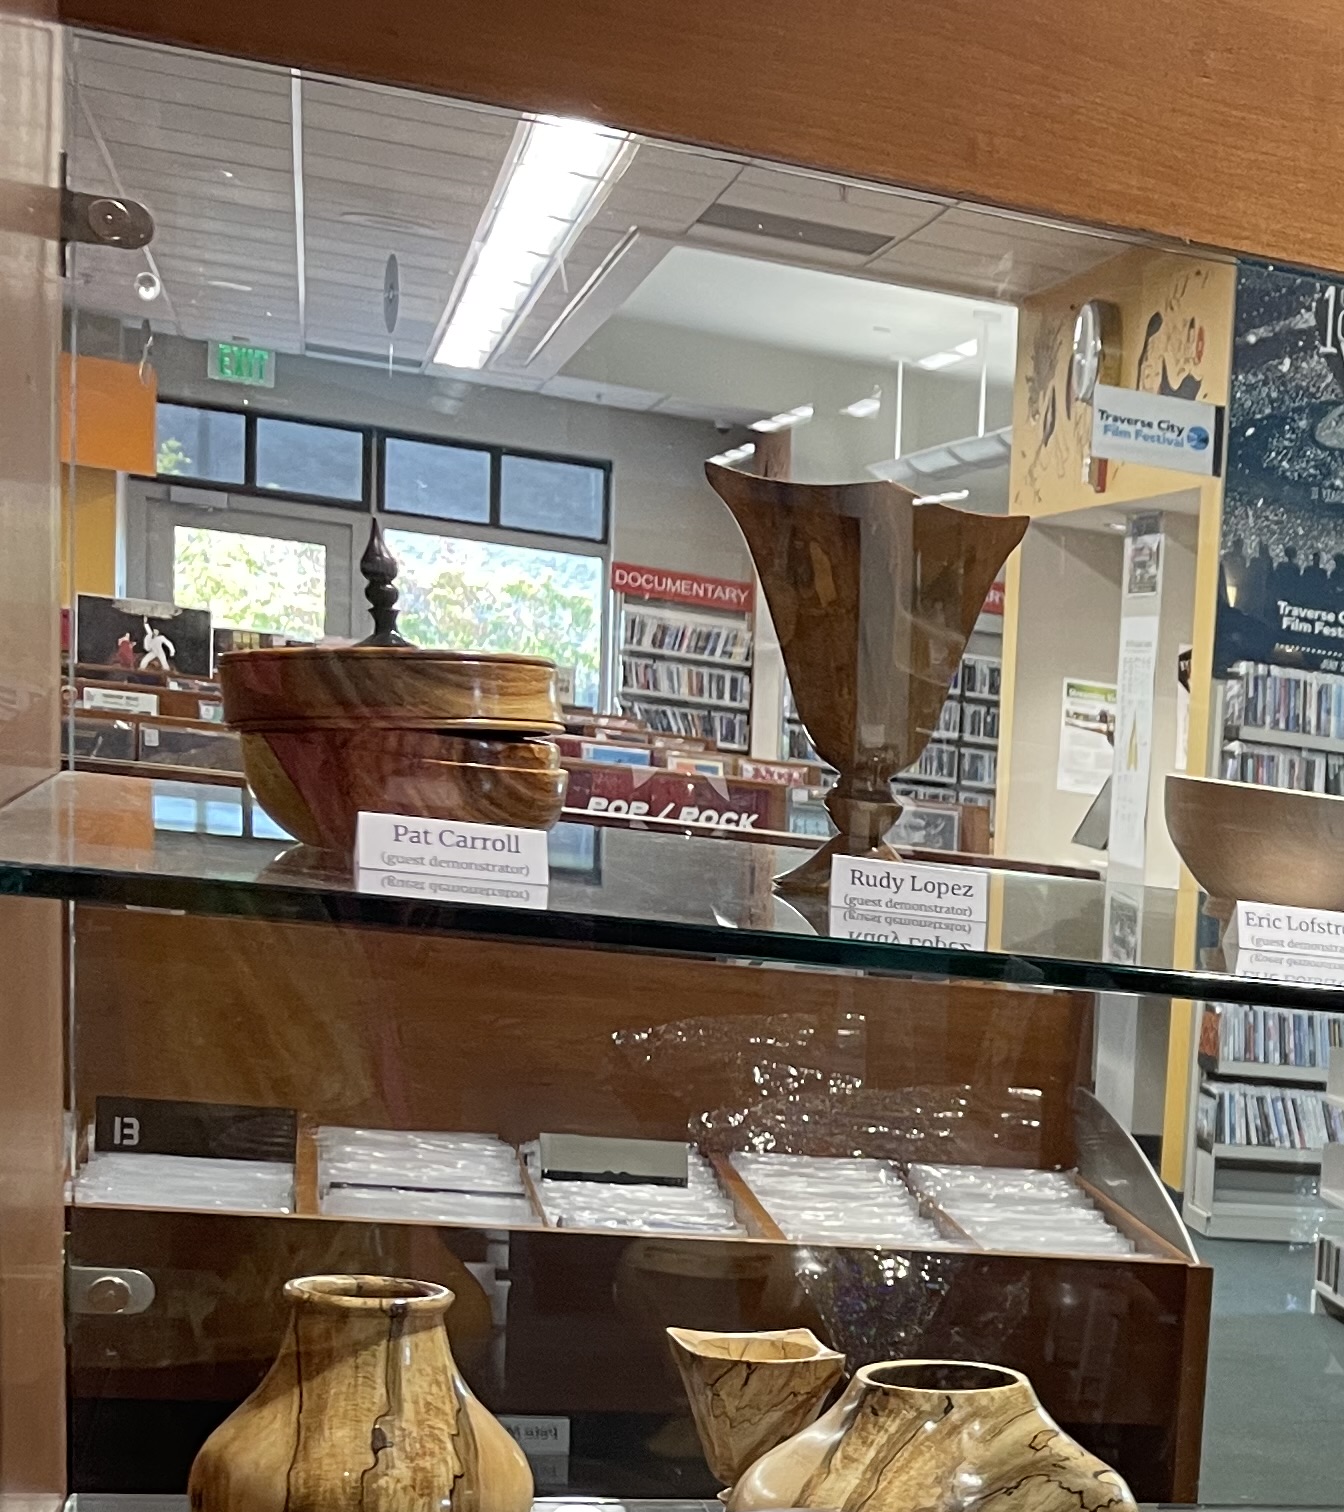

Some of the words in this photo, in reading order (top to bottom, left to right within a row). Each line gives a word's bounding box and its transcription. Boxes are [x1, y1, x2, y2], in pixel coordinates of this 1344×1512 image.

[218, 344, 269, 380] EXIT
[1098, 409, 1153, 429] Traverse
[1157, 420, 1185, 437] City
[1103, 424, 1131, 439] Film
[1135, 429, 1184, 447] Festival
[615, 569, 749, 605] DOCUMENTARY
[1277, 600, 1336, 622] Traverse
[1282, 616, 1312, 633] Film
[587, 796, 649, 815] POP
[679, 806, 759, 829] ROCK
[393, 824, 431, 845] Pat
[439, 829, 521, 853] Carroll
[381, 851, 425, 866] (guest
[429, 856, 530, 876] demonstrator)
[850, 869, 904, 894] Rudy
[910, 875, 974, 899] Lopez
[844, 894, 882, 907] (guest
[885, 898, 972, 917] demonstrator)
[1245, 911, 1282, 929] Eric
[1251, 936, 1285, 948] (guest
